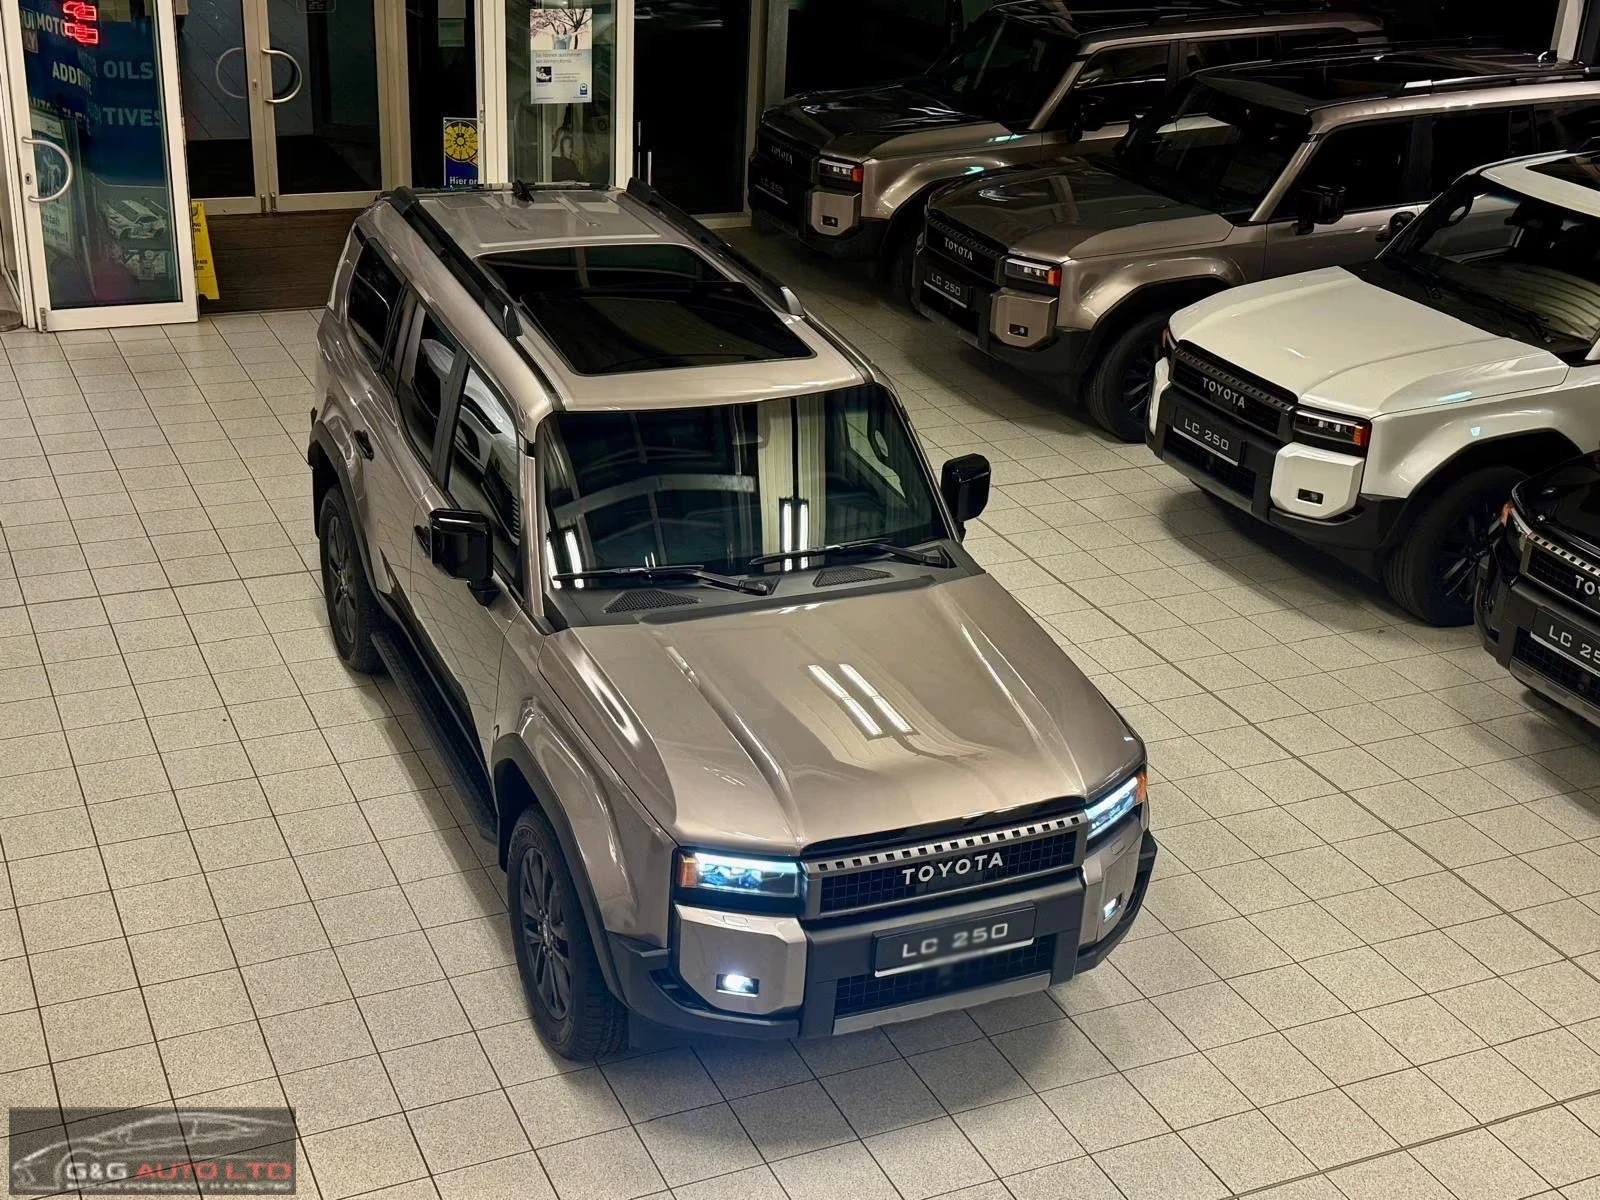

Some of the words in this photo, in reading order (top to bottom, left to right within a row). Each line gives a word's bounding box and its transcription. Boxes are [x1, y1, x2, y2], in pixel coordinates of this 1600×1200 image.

[103, 60, 154, 80] OILS
[944, 236, 973, 261] TOYOTA
[931, 272, 942, 286] LC
[944, 280, 961, 296] 250
[1202, 376, 1246, 409] TOYOTA
[1184, 418, 1200, 435] LC
[1204, 429, 1229, 451] 250
[1575, 574, 1600, 600] TO
[1549, 625, 1572, 648] LC
[902, 851, 1004, 886] TOYOTA
[902, 938, 938, 959] LC
[952, 923, 1009, 948] 250
